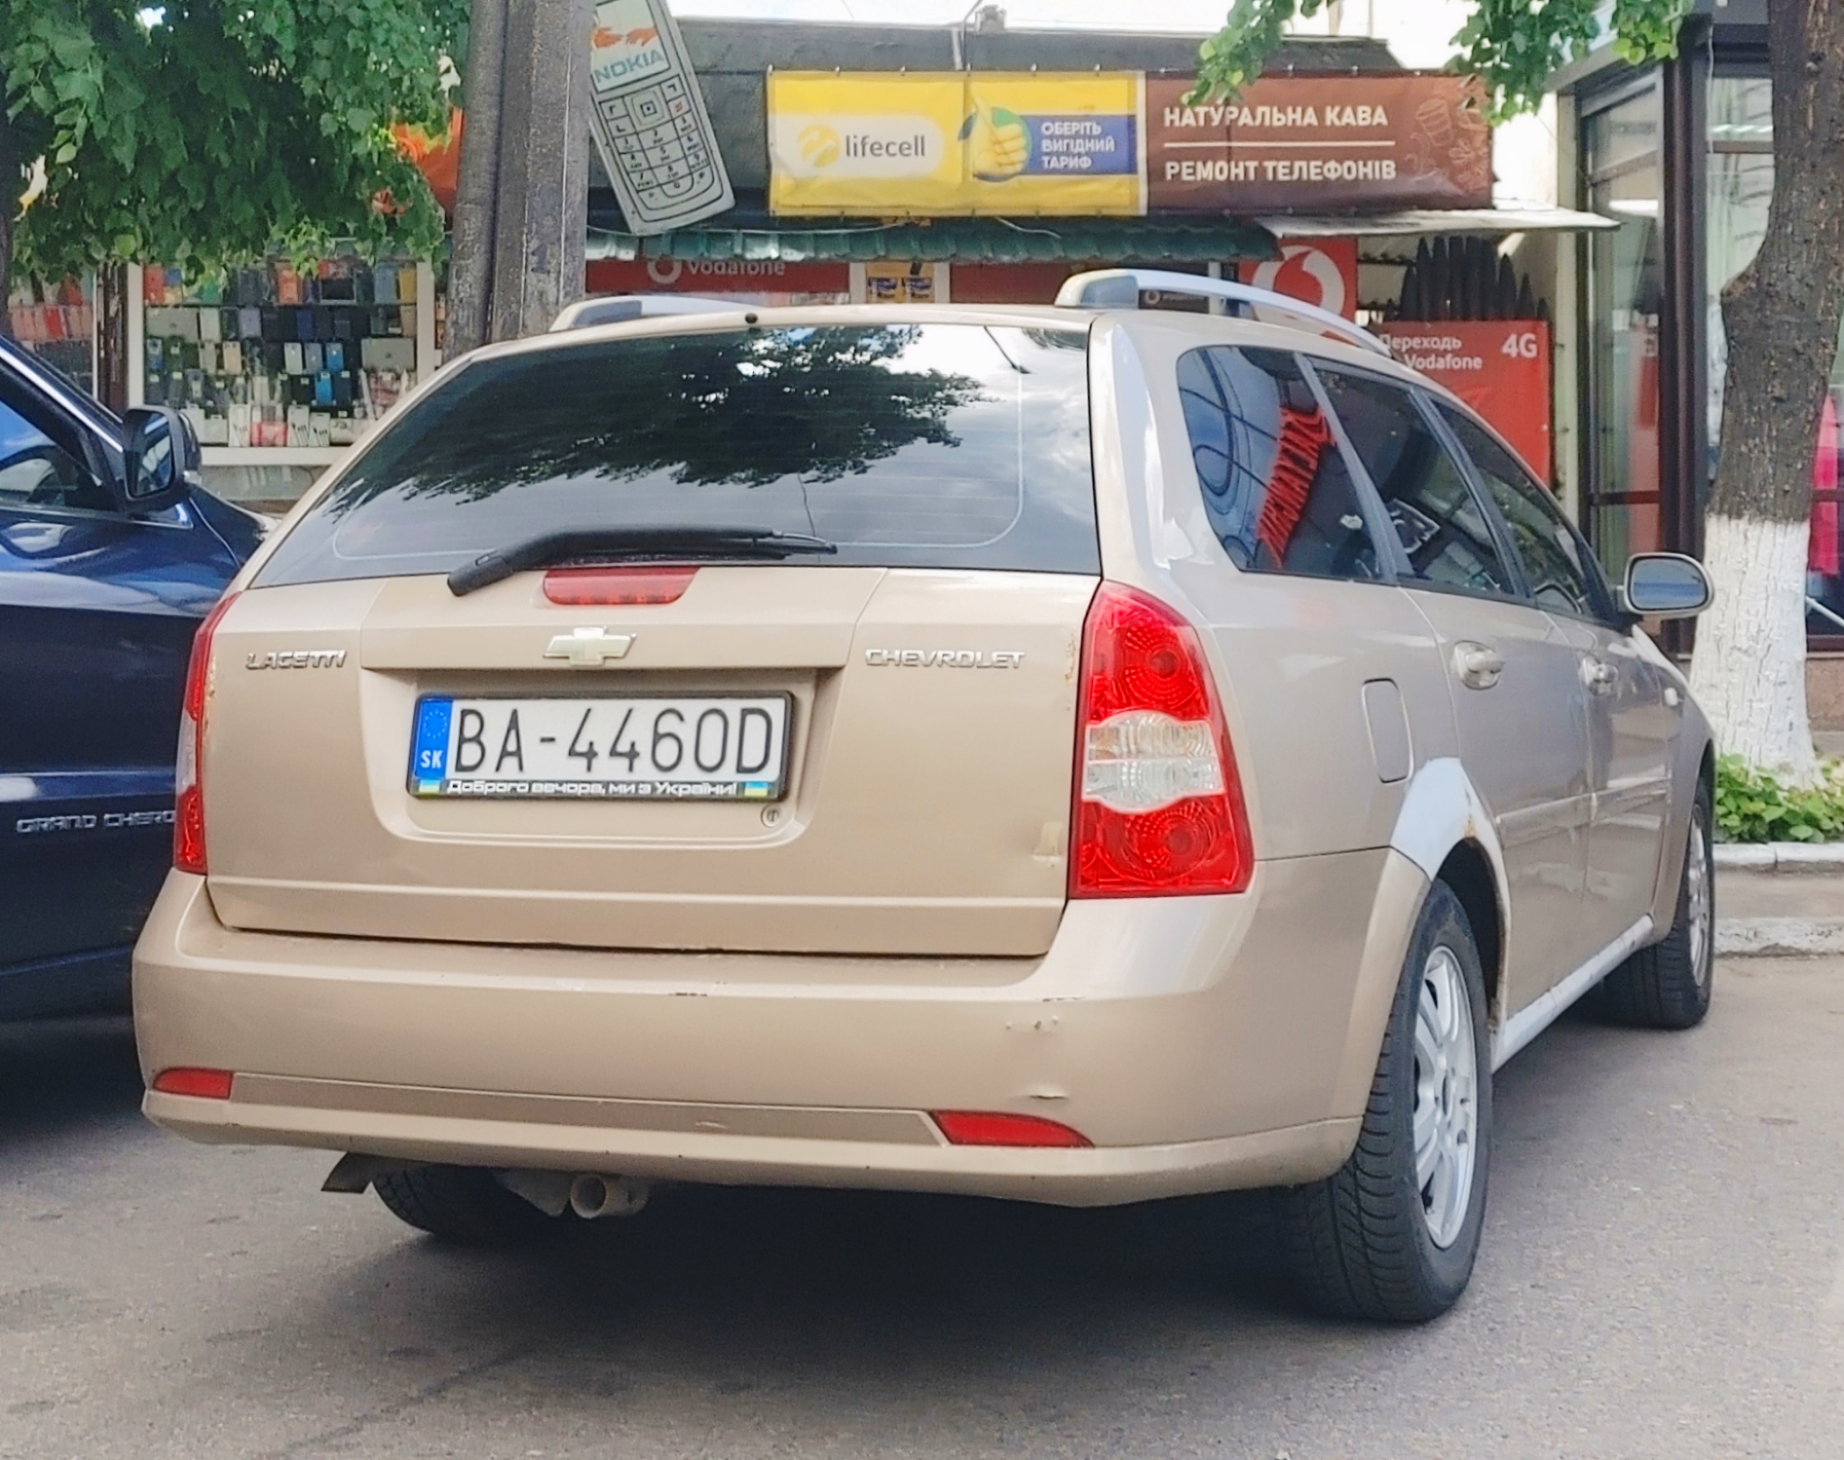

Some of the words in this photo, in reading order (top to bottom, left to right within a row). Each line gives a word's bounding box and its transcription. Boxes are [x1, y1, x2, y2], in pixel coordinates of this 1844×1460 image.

[594, 50, 664, 83] NOKIA
[1163, 106, 1319, 128] НАТУРАЛЬНА
[1325, 105, 1389, 127] КАВА
[1041, 121, 1102, 135] ОБЕРІТЬ
[845, 134, 926, 157] lifecell
[1041, 136, 1116, 154] ВИГІДНИЙ
[1042, 155, 1093, 170] ТАРИФ
[1164, 160, 1259, 181] РЕМОНТ
[1262, 159, 1397, 181] ТЕЛЕФОНІВ
[1380, 334, 1462, 352] Переходь
[1502, 332, 1538, 358] 4G
[1403, 354, 1483, 370] Vodafone
[246, 649, 347, 670] LACETTI
[865, 649, 1025, 669] CHEVROLET
[420, 749, 443, 769] SK
[447, 780, 530, 795] Доброго
[608, 783, 635, 795] ми
[638, 783, 651, 795] з
[654, 782, 738, 798] України!
[16, 814, 97, 833] GRAND
